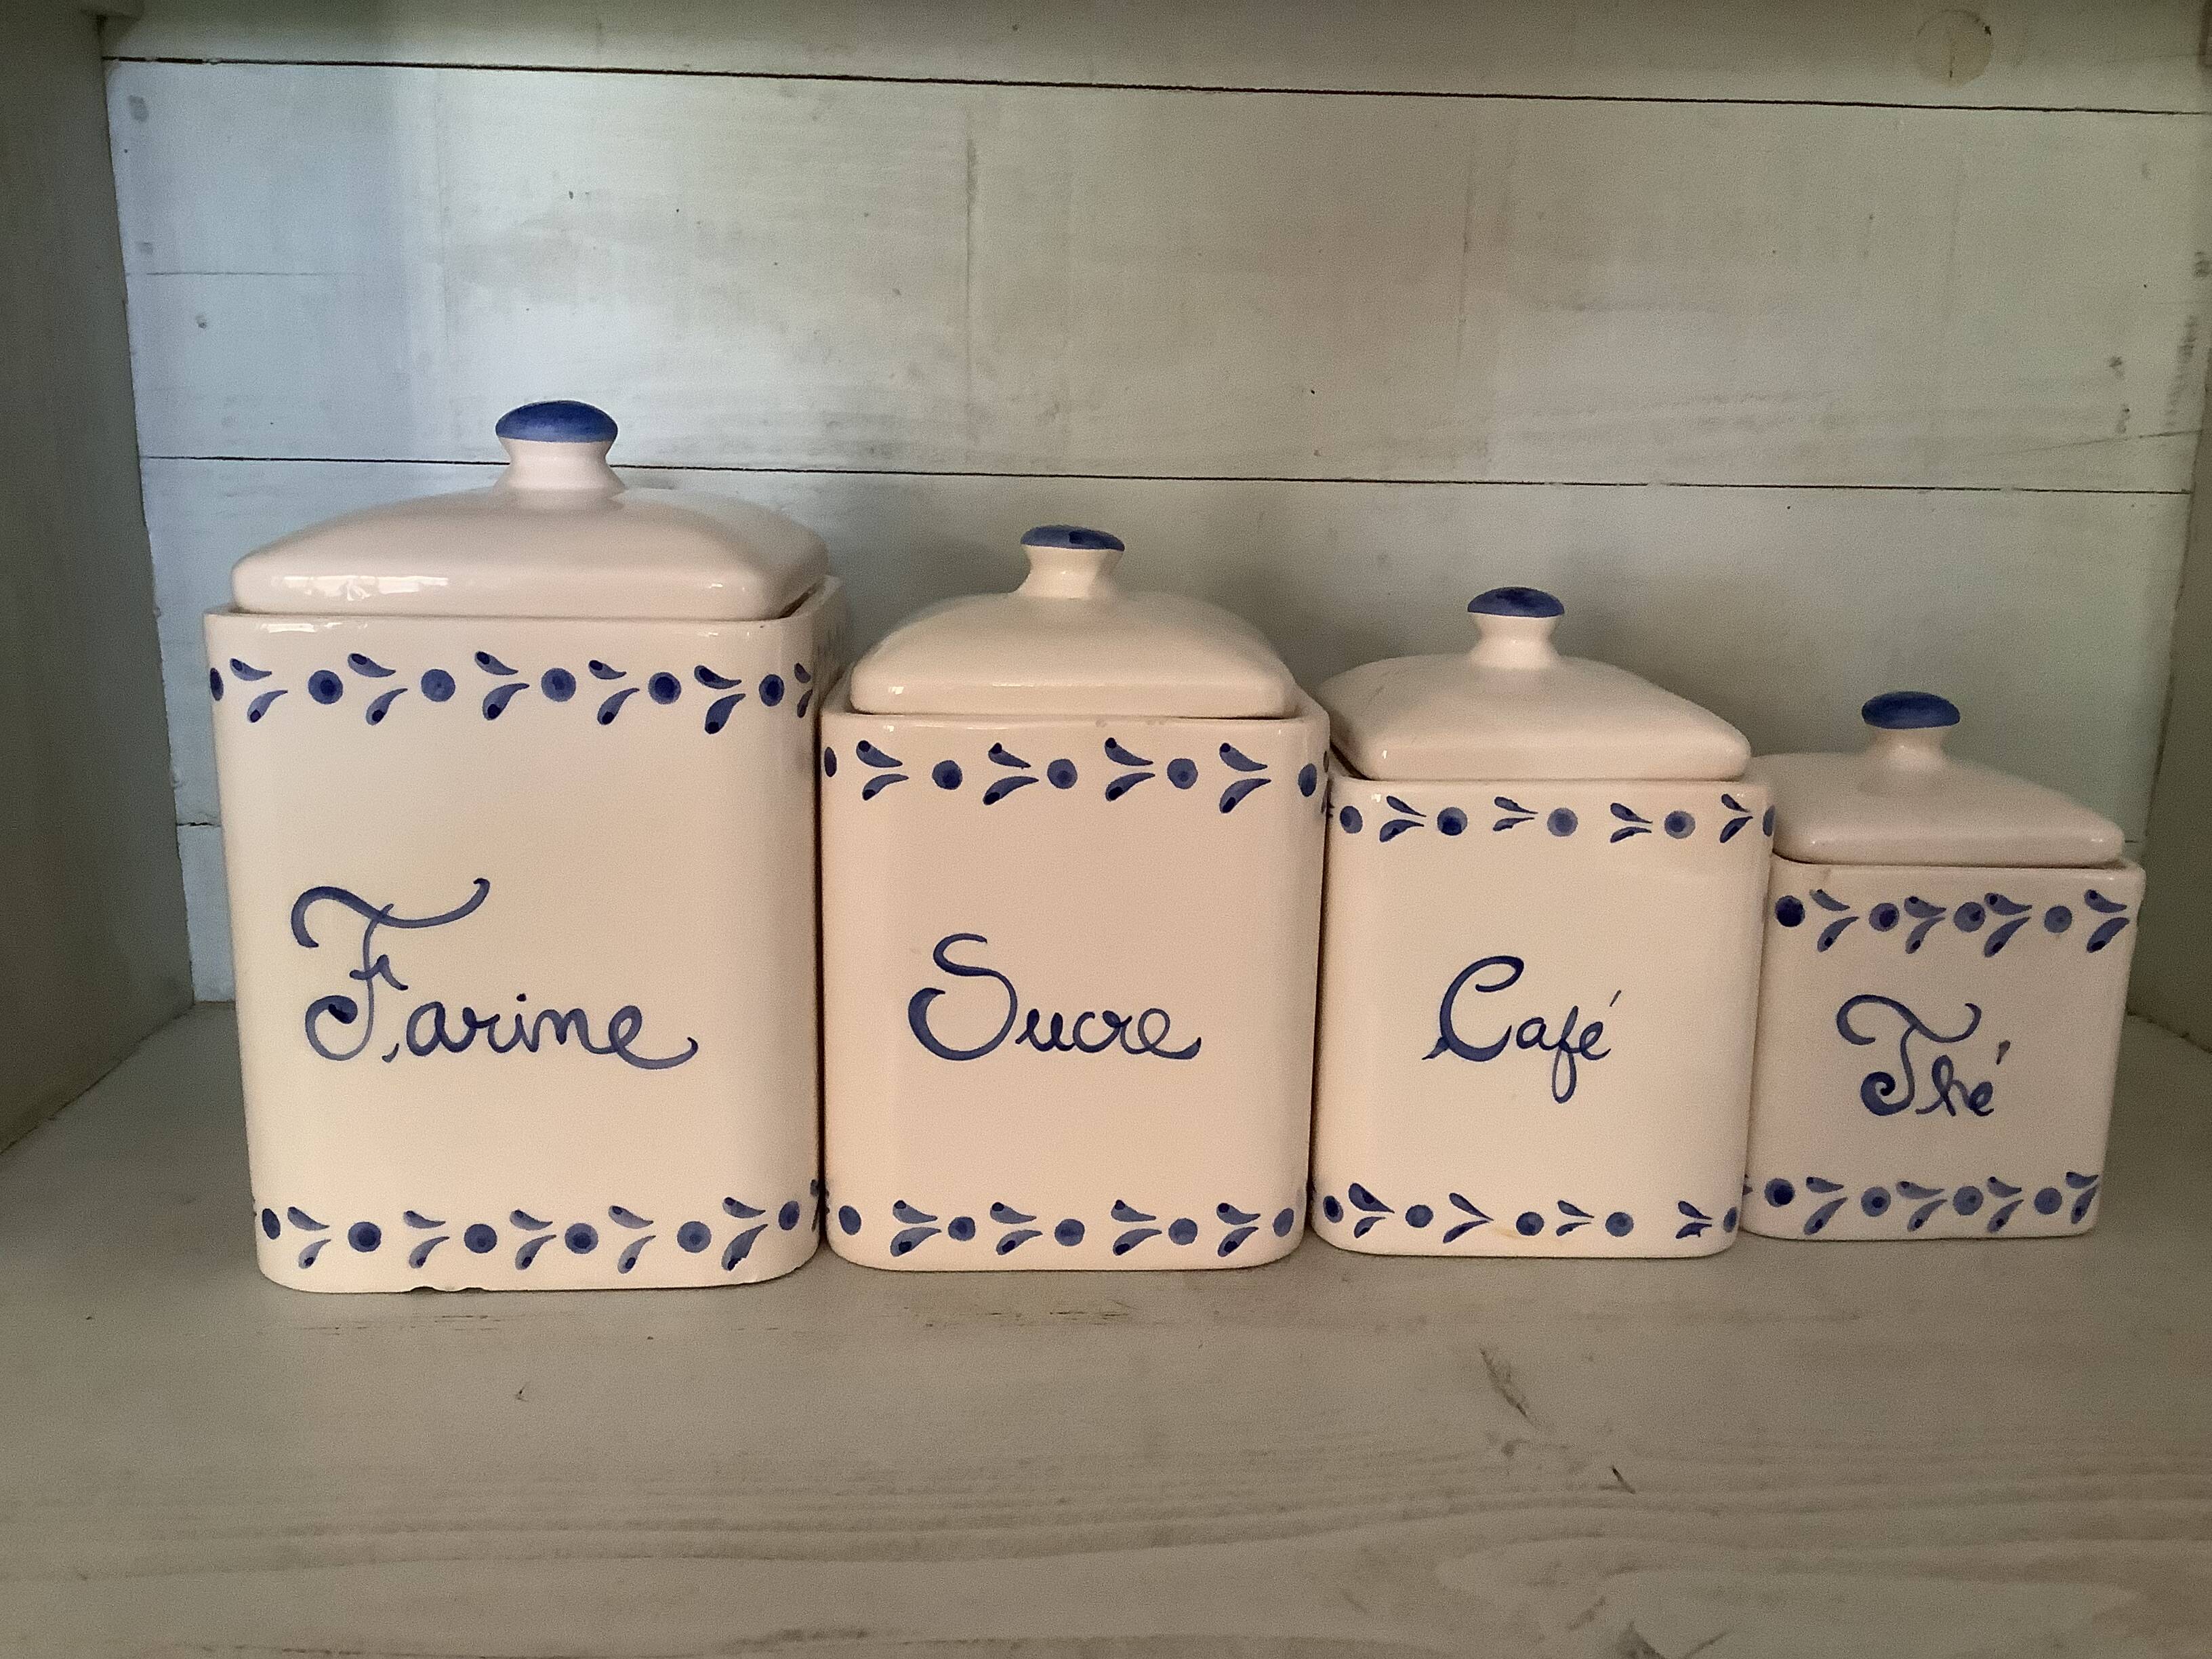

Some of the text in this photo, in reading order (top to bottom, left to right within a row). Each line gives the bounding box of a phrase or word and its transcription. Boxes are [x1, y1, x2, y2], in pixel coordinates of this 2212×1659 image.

[291, 878, 699, 1070] Farine
[907, 933, 1202, 1061] Sucre
[1421, 955, 1622, 1103] Café
[1836, 994, 2011, 1117] Thé
